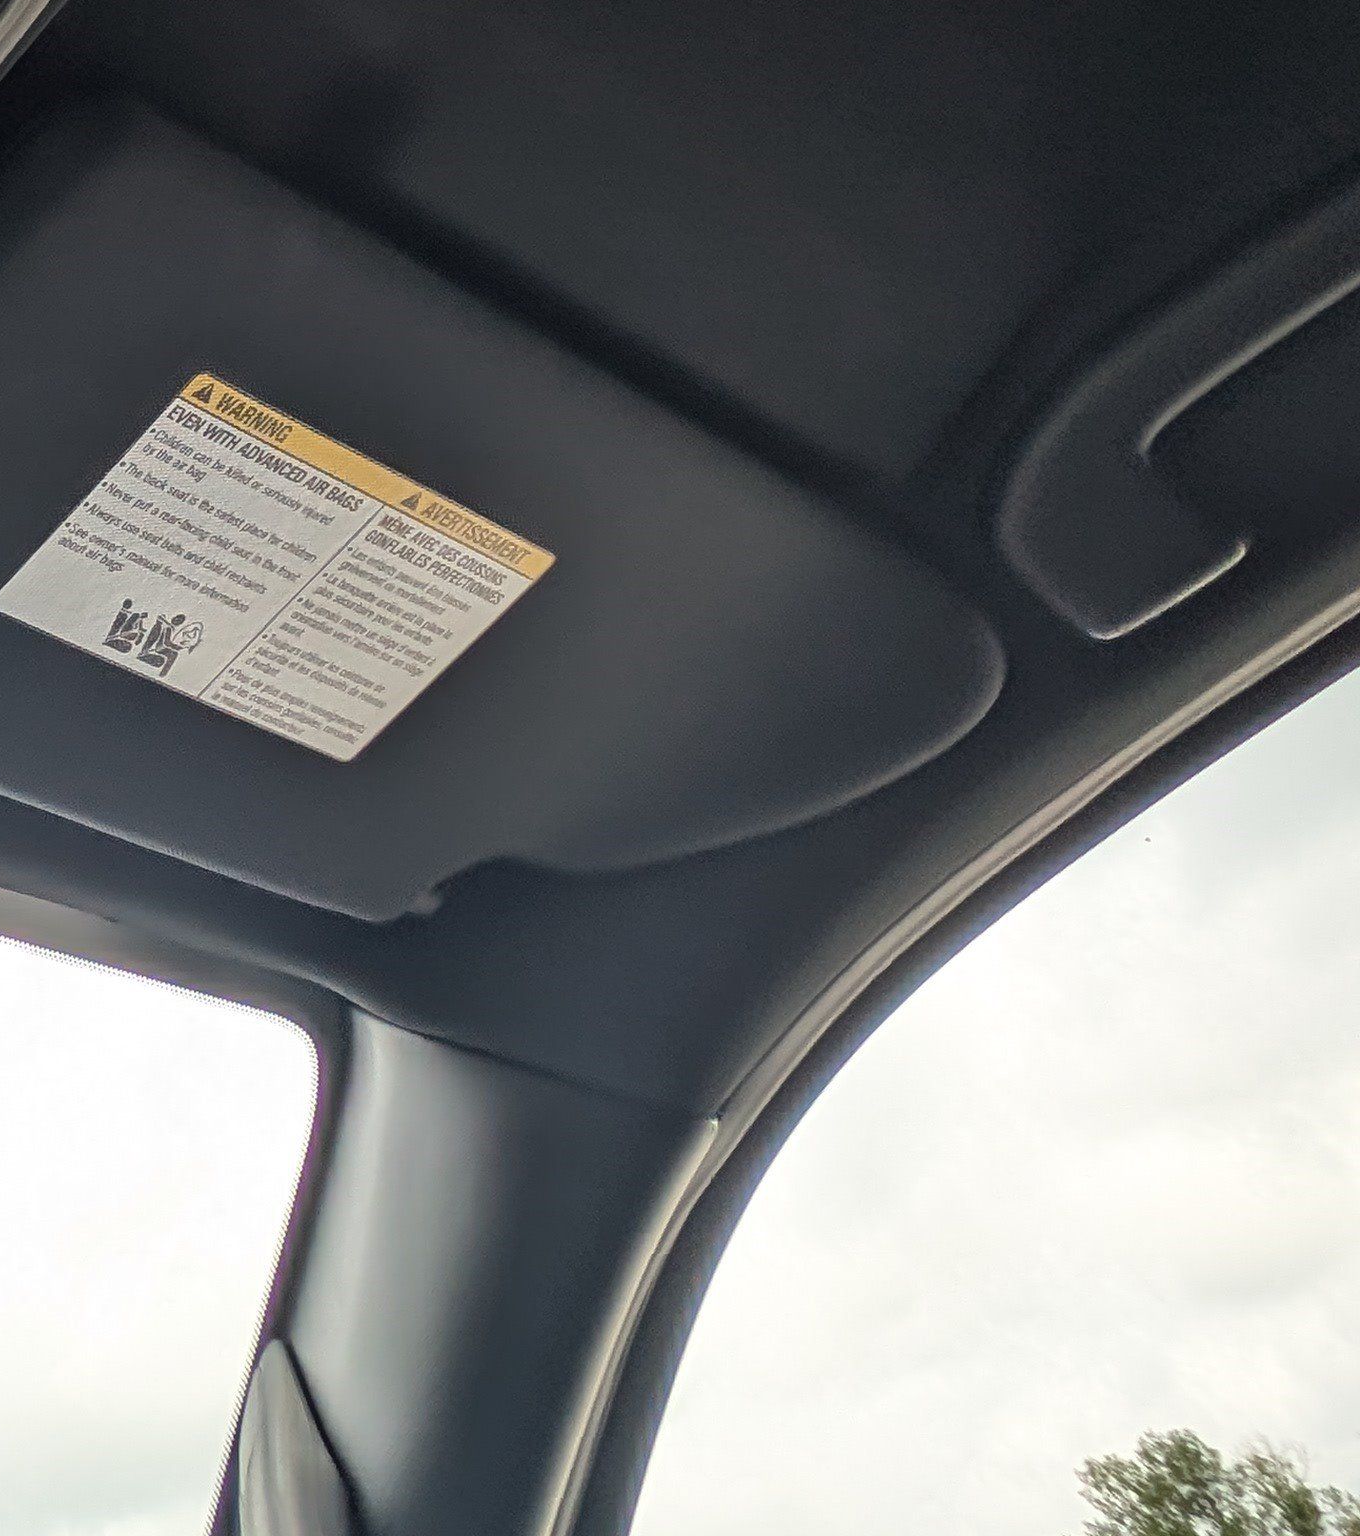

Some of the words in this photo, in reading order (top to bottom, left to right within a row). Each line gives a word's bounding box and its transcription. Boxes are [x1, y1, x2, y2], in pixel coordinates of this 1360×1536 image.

[216, 393, 293, 443] WARNING
[166, 404, 207, 433] EVEN
[202, 422, 242, 451] WITH
[237, 442, 308, 483] ADVANCED
[301, 475, 331, 496] AIR
[324, 486, 364, 512] BAGS
[365, 529, 432, 568] GONFLABLES
[408, 530, 441, 552] AVEC
[435, 544, 462, 563] DES
[421, 503, 531, 564] AVERTISSEMENT
